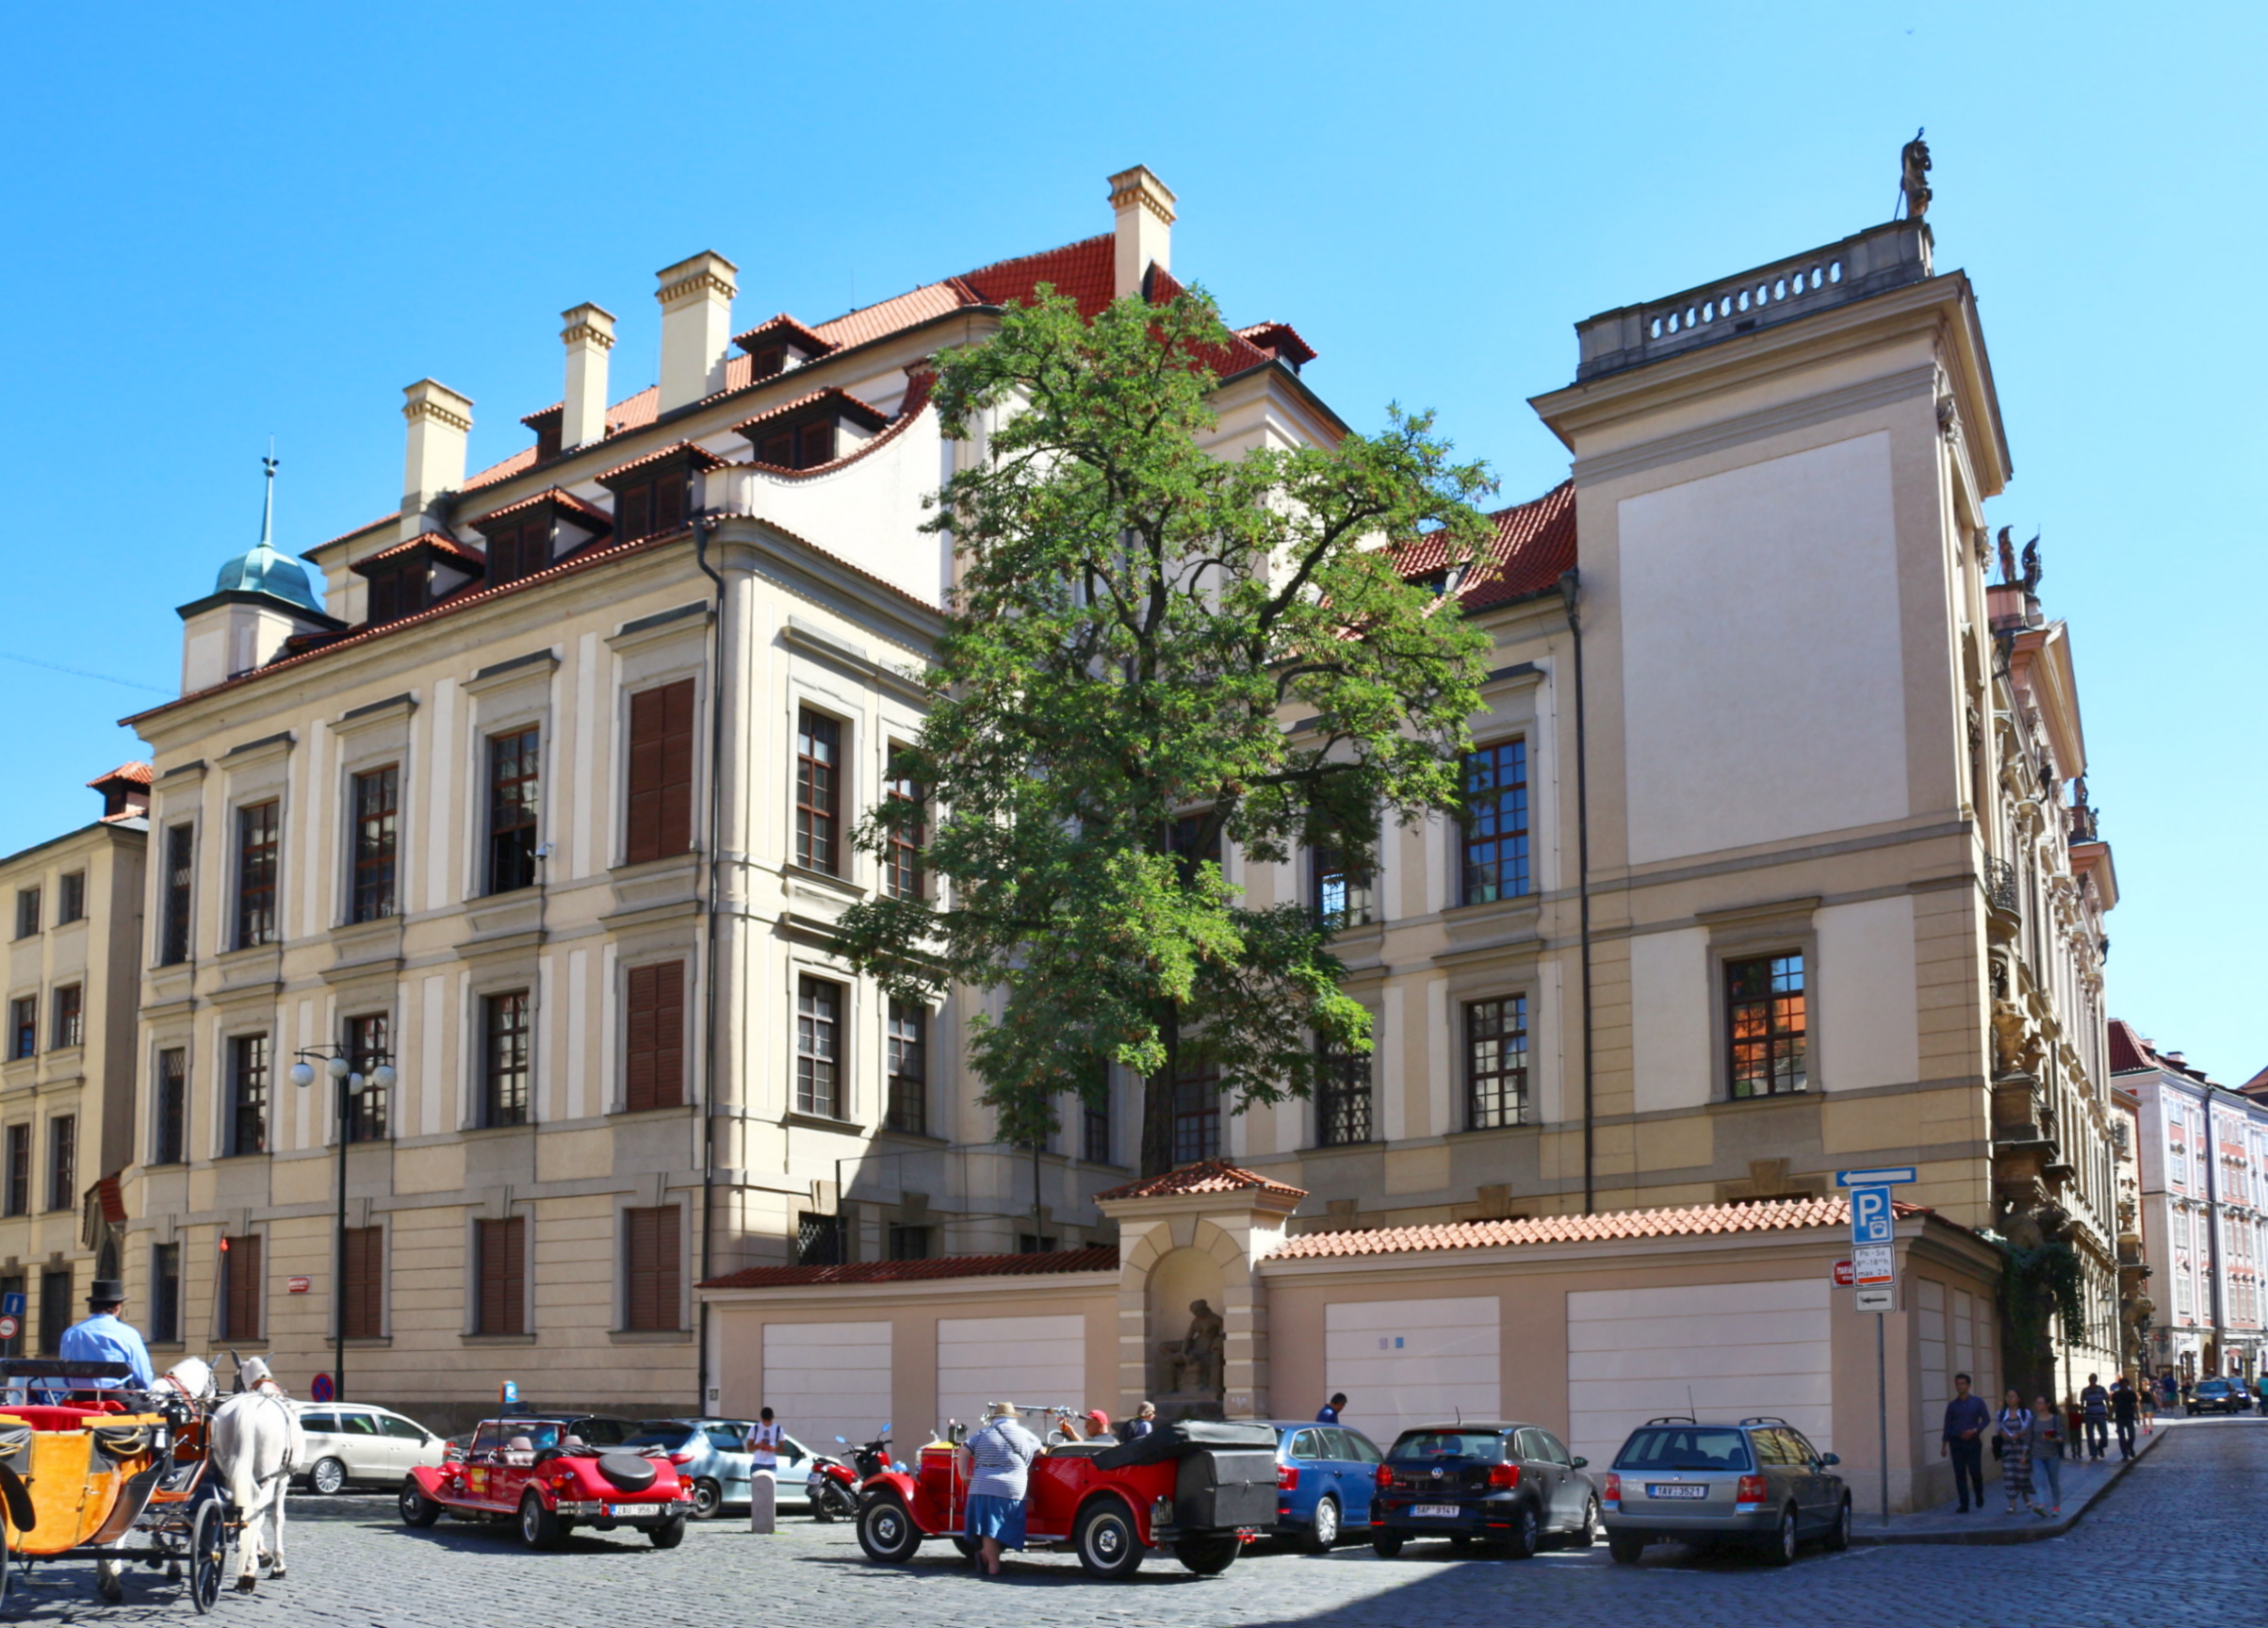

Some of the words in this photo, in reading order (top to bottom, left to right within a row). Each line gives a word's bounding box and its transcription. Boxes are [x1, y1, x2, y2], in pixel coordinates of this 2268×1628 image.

[1859, 1194, 1882, 1227] P
[1658, 1487, 1672, 1495] 1AV
[1679, 1487, 1700, 1495] 3521
[617, 1506, 632, 1515] 2AU
[1436, 1506, 1457, 1514] 9141
